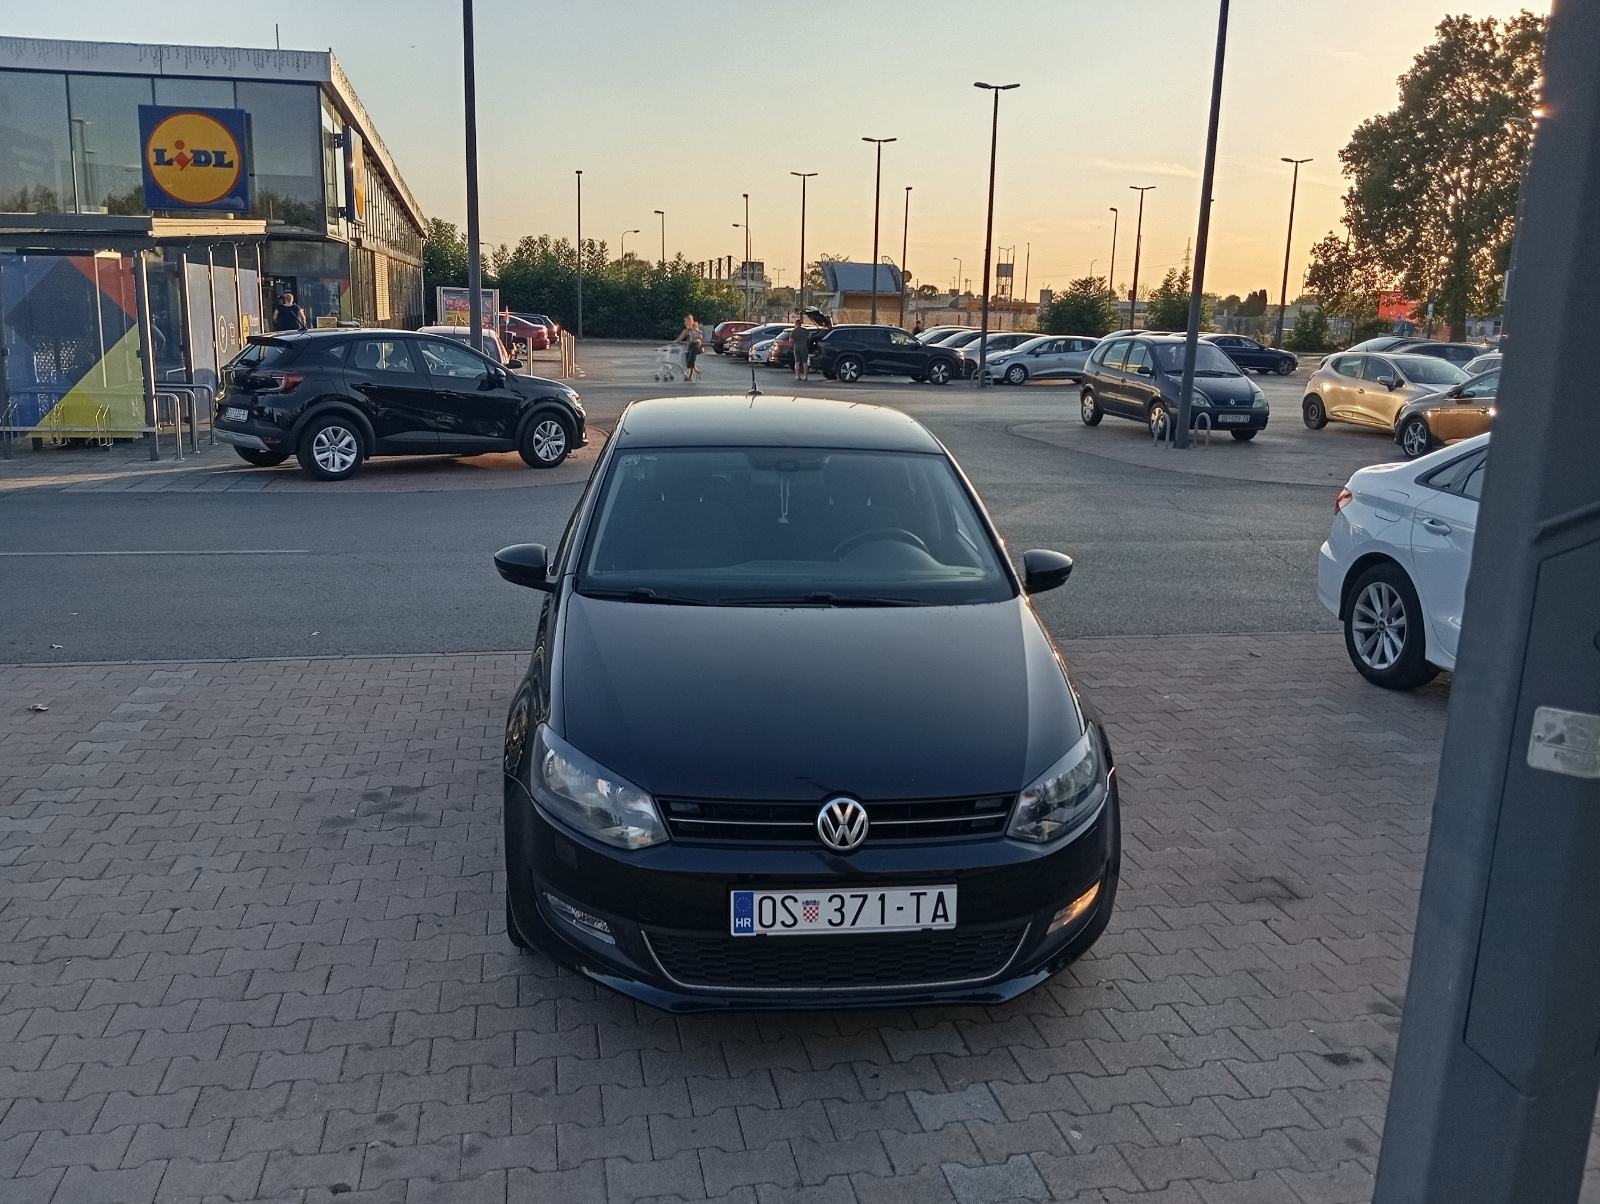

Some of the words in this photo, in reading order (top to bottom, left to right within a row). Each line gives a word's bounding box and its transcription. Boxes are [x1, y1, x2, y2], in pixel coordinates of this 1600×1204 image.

[758, 894, 799, 929] OS
[827, 890, 950, 927] 371-TA
[735, 917, 752, 929] HR
